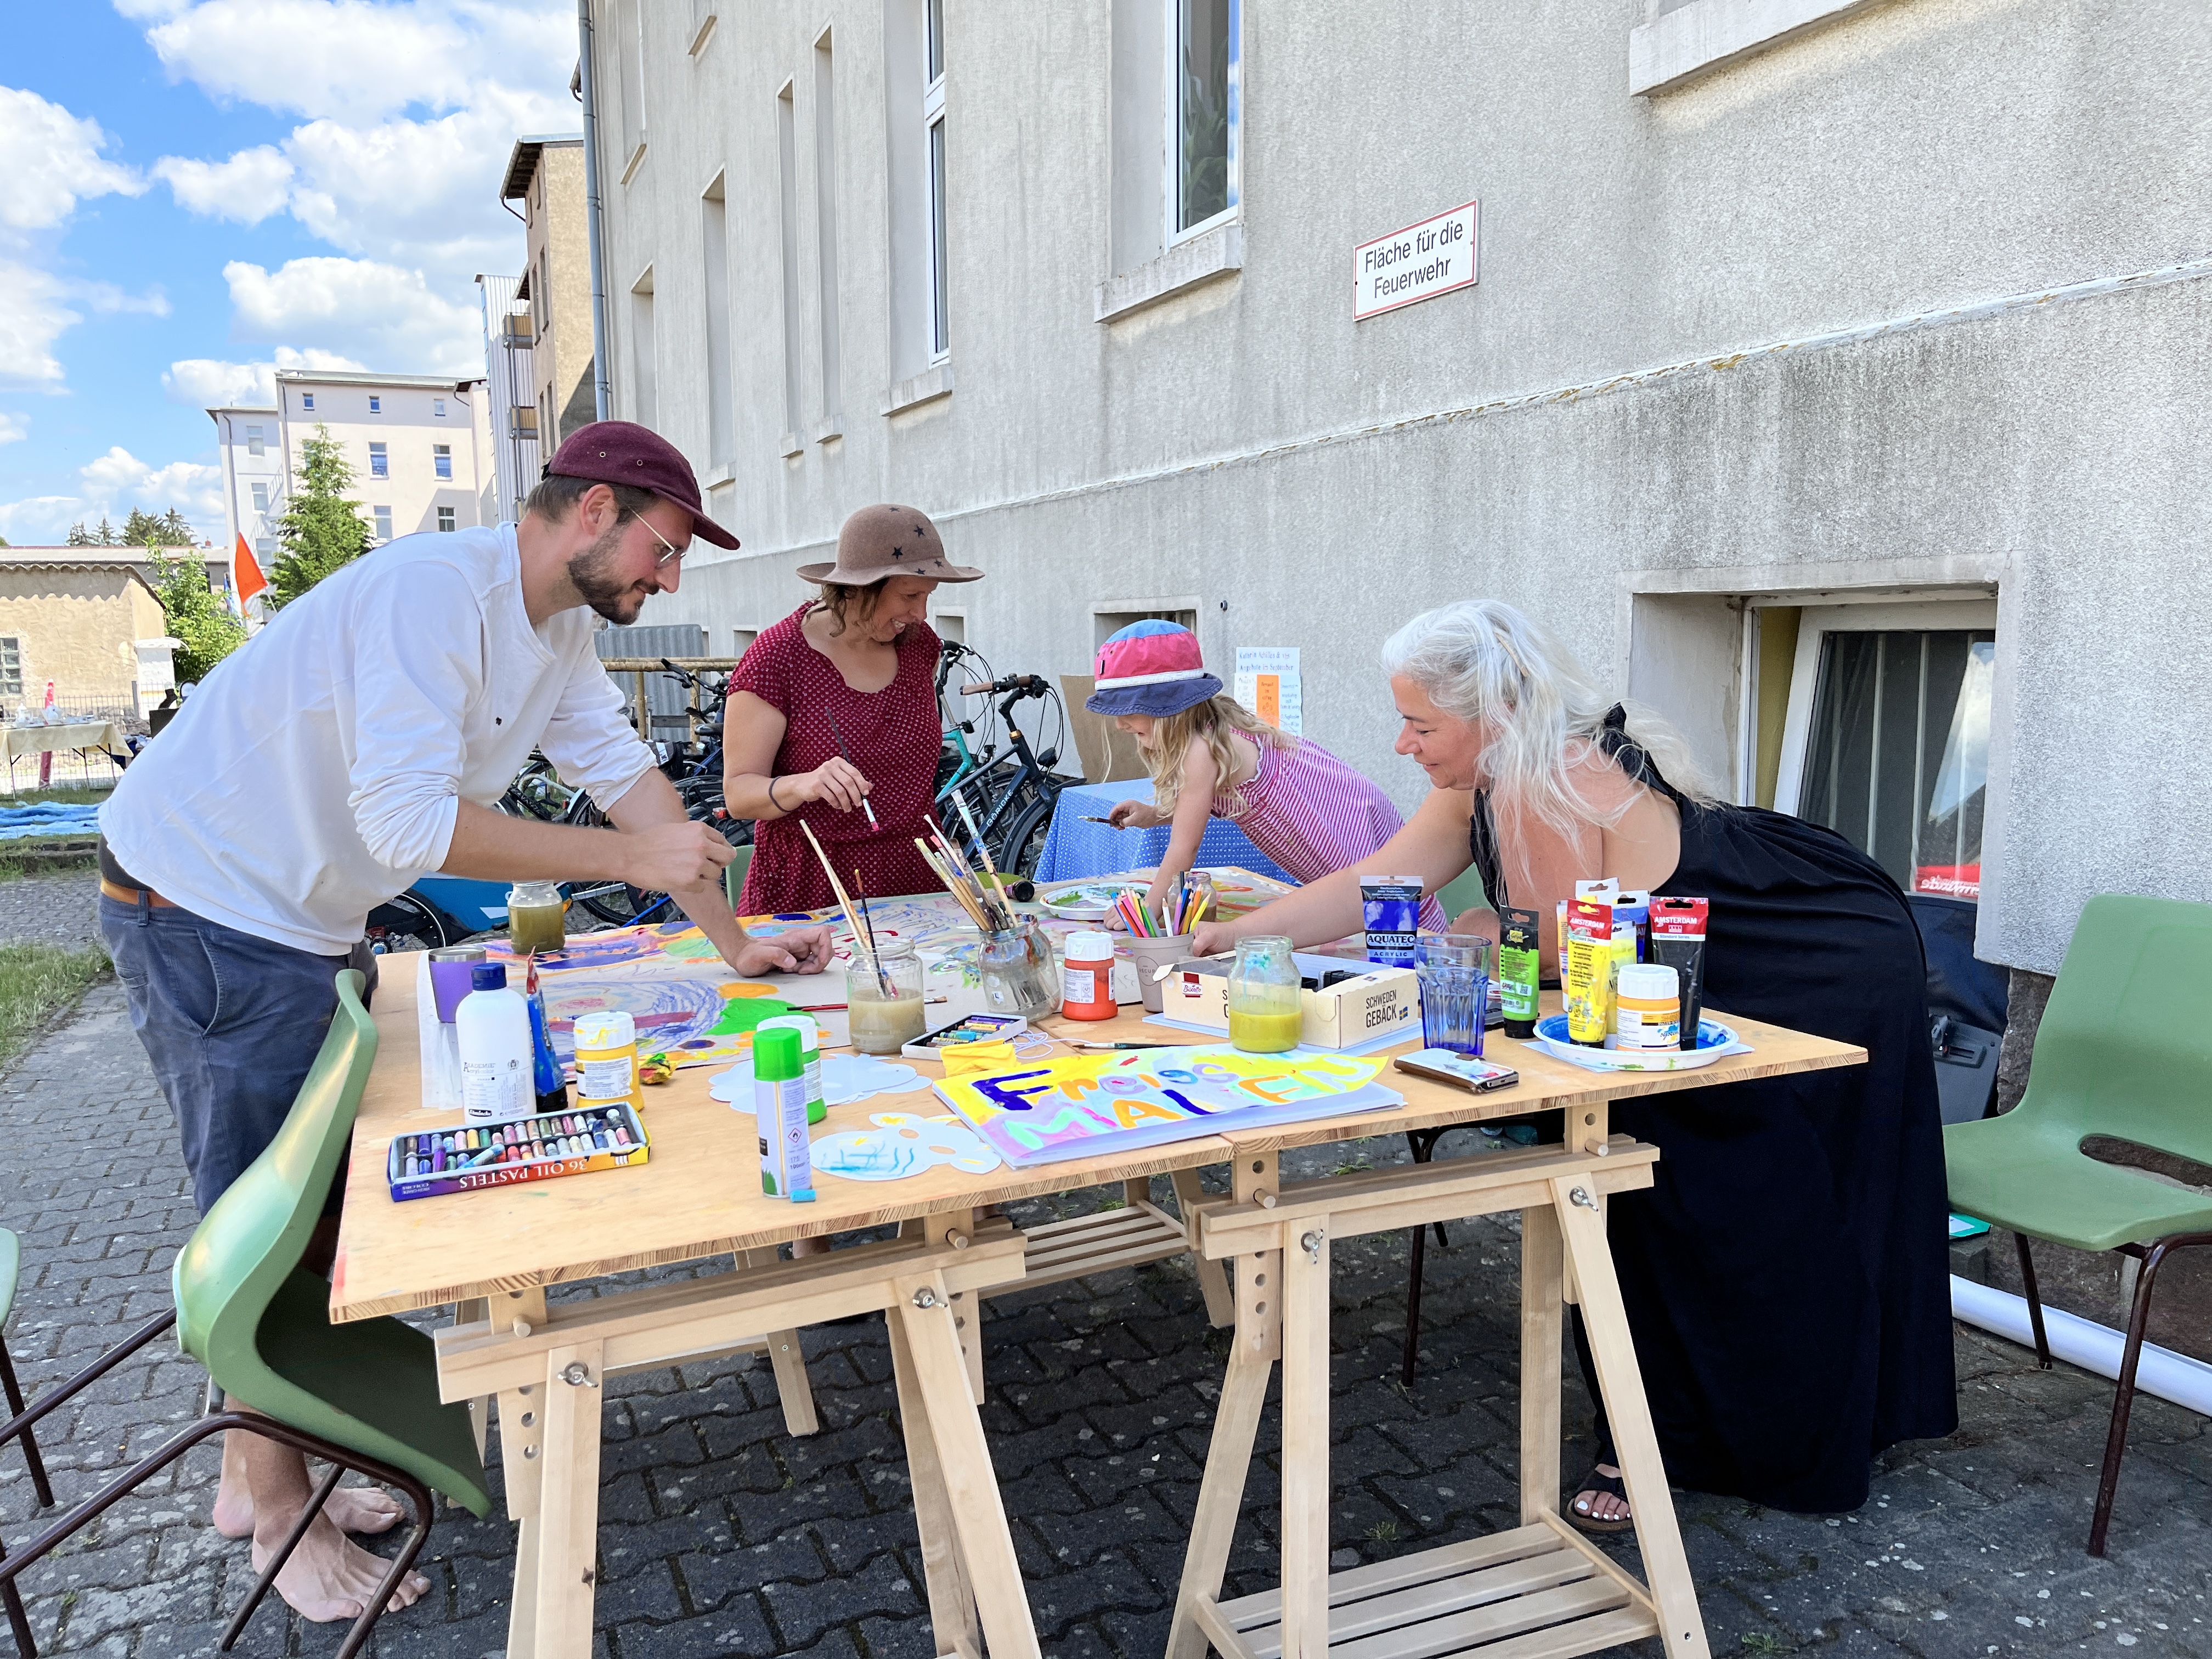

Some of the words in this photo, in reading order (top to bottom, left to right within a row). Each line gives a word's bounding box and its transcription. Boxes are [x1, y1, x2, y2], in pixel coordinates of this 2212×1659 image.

[1365, 241, 1411, 273] Fläche
[1416, 229, 1437, 255] für
[1440, 220, 1463, 246] die
[1374, 257, 1451, 299] Feuerwehr
[1239, 664, 1261, 672] Angebote
[1269, 664, 1293, 672] September
[1570, 917, 1605, 929] AMSTERDAM
[1654, 916, 1697, 924] AMSTERDAM
[1368, 935, 1414, 944] AQUATEC
[1365, 989, 1397, 1009] SCHWEDEN
[1365, 1003, 1397, 1028] GEBÄCK
[534, 1163, 565, 1177] OIL
[569, 1159, 587, 1172] 36
[459, 1167, 528, 1188] PASTELS
